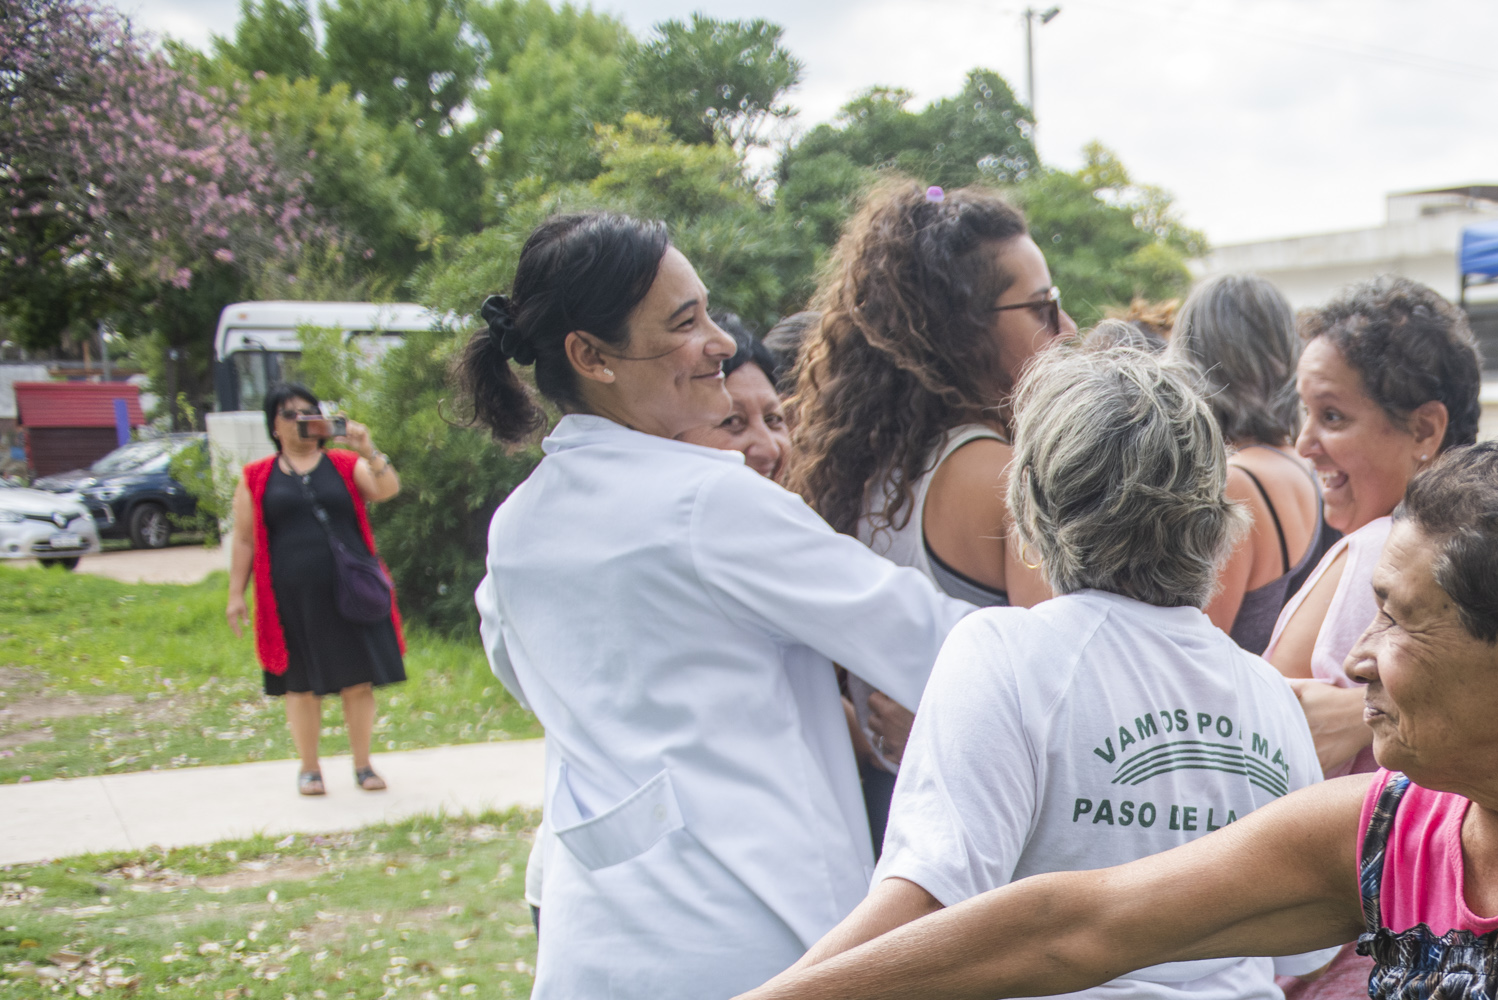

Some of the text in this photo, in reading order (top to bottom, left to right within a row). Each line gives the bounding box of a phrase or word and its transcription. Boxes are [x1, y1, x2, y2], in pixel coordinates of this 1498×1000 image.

[1093, 708, 1190, 764] VAMOS
[1197, 712, 1243, 740] PO
[1072, 798, 1157, 828] PASO
